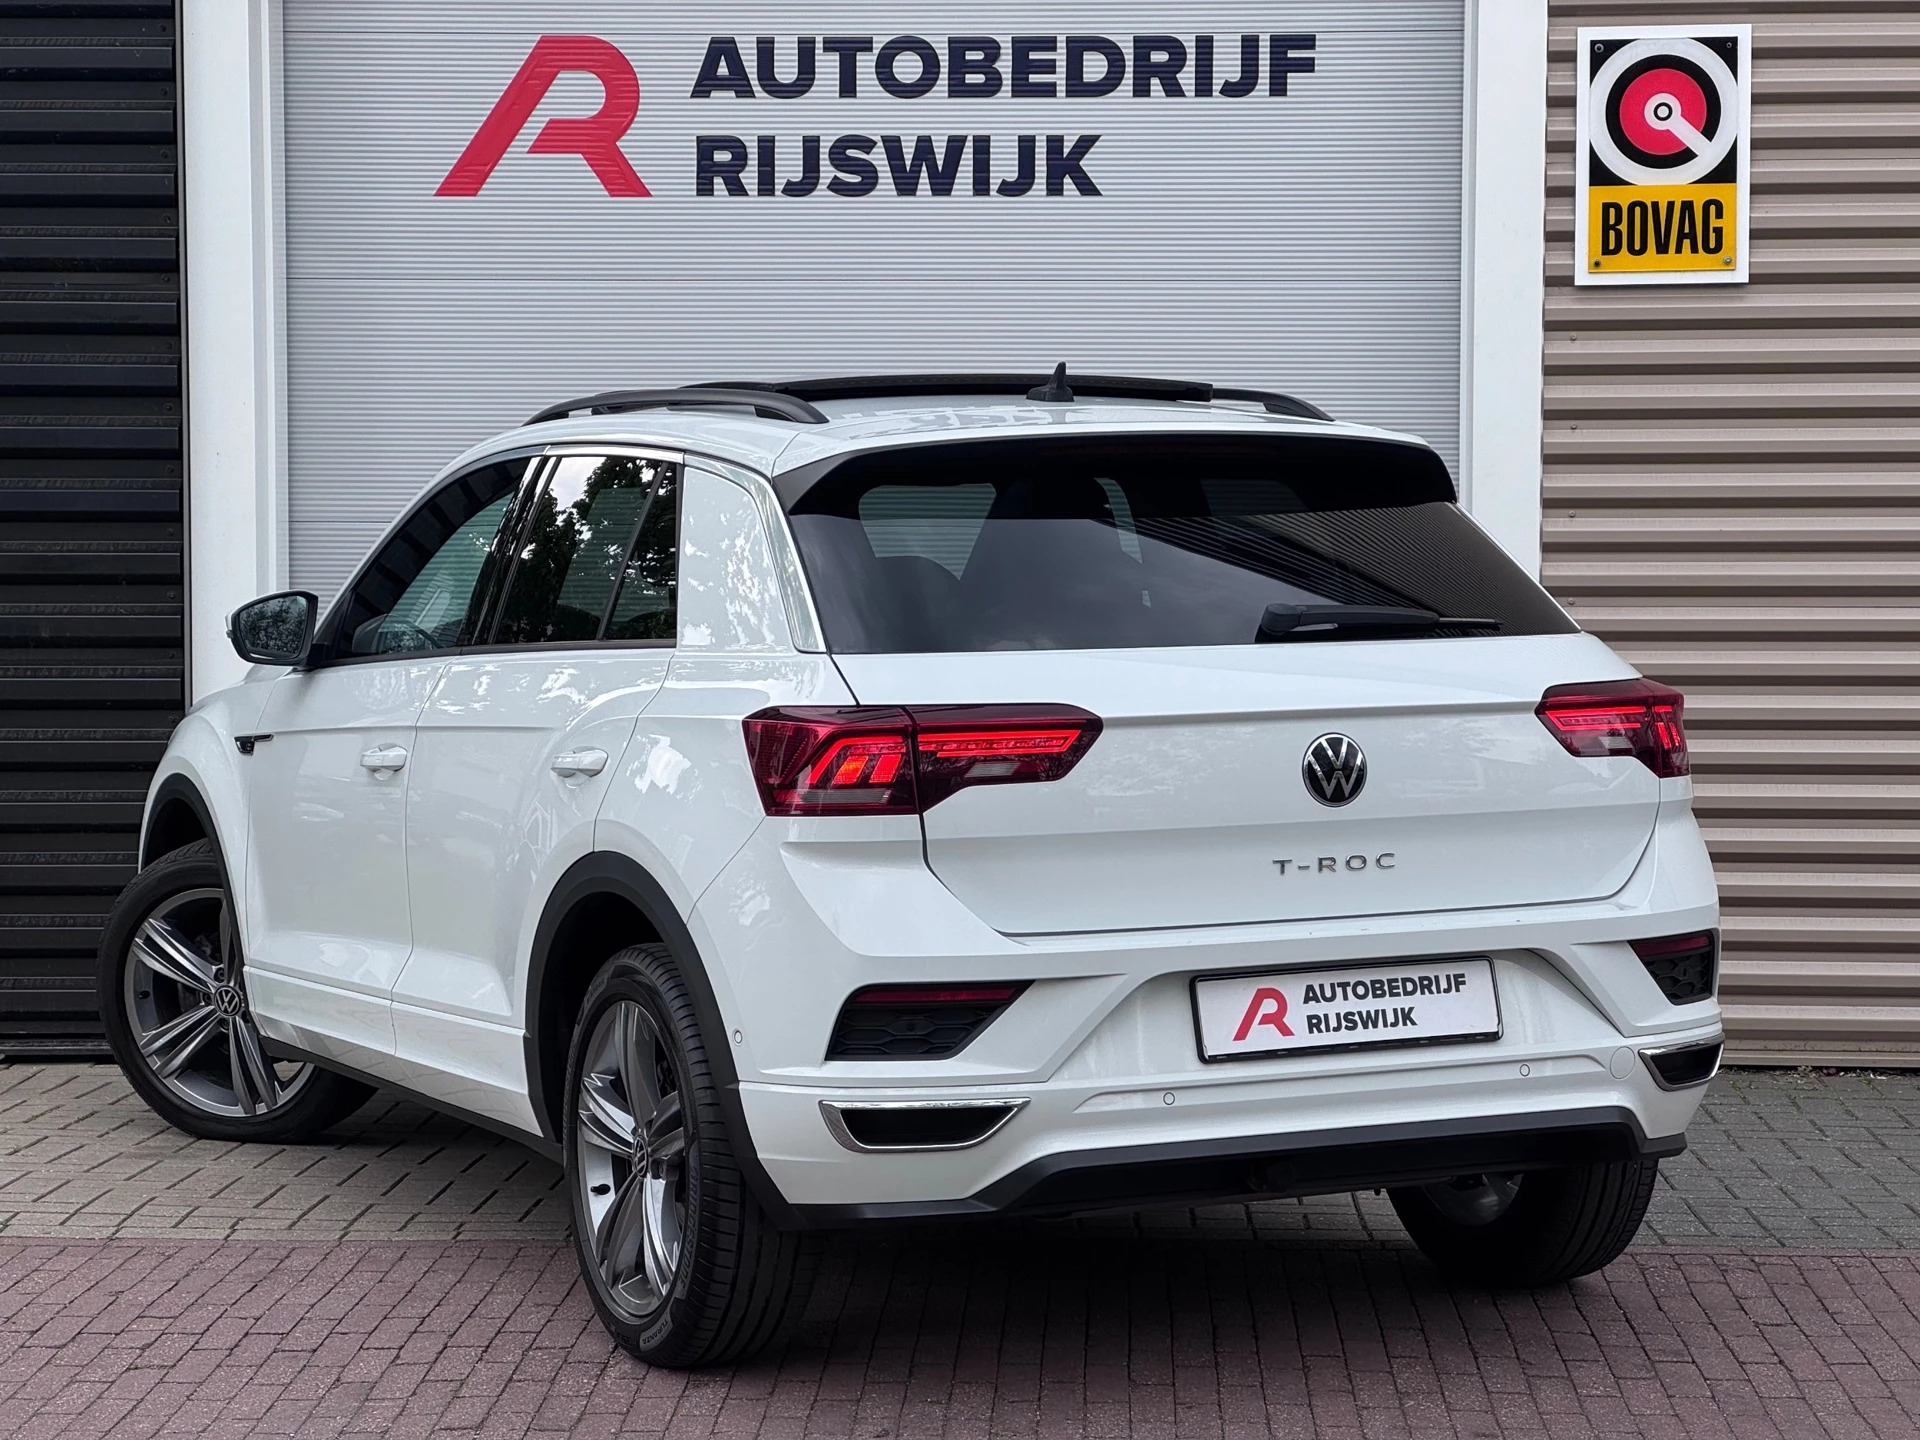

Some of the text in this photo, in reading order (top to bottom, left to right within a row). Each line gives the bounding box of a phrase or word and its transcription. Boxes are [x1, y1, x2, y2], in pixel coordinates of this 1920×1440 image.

[691, 35, 1317, 99] AUTOBEDRIJF
[697, 135, 1102, 197] RIJSWIJK
[1601, 199, 1724, 257] BOVAG
[1272, 852, 1396, 876] T-ROC
[1303, 973, 1466, 1005] AUTOBEDRIJF
[1306, 1006, 1418, 1034] RIJSWIJK
[641, 1317, 669, 1345] TURANZA
